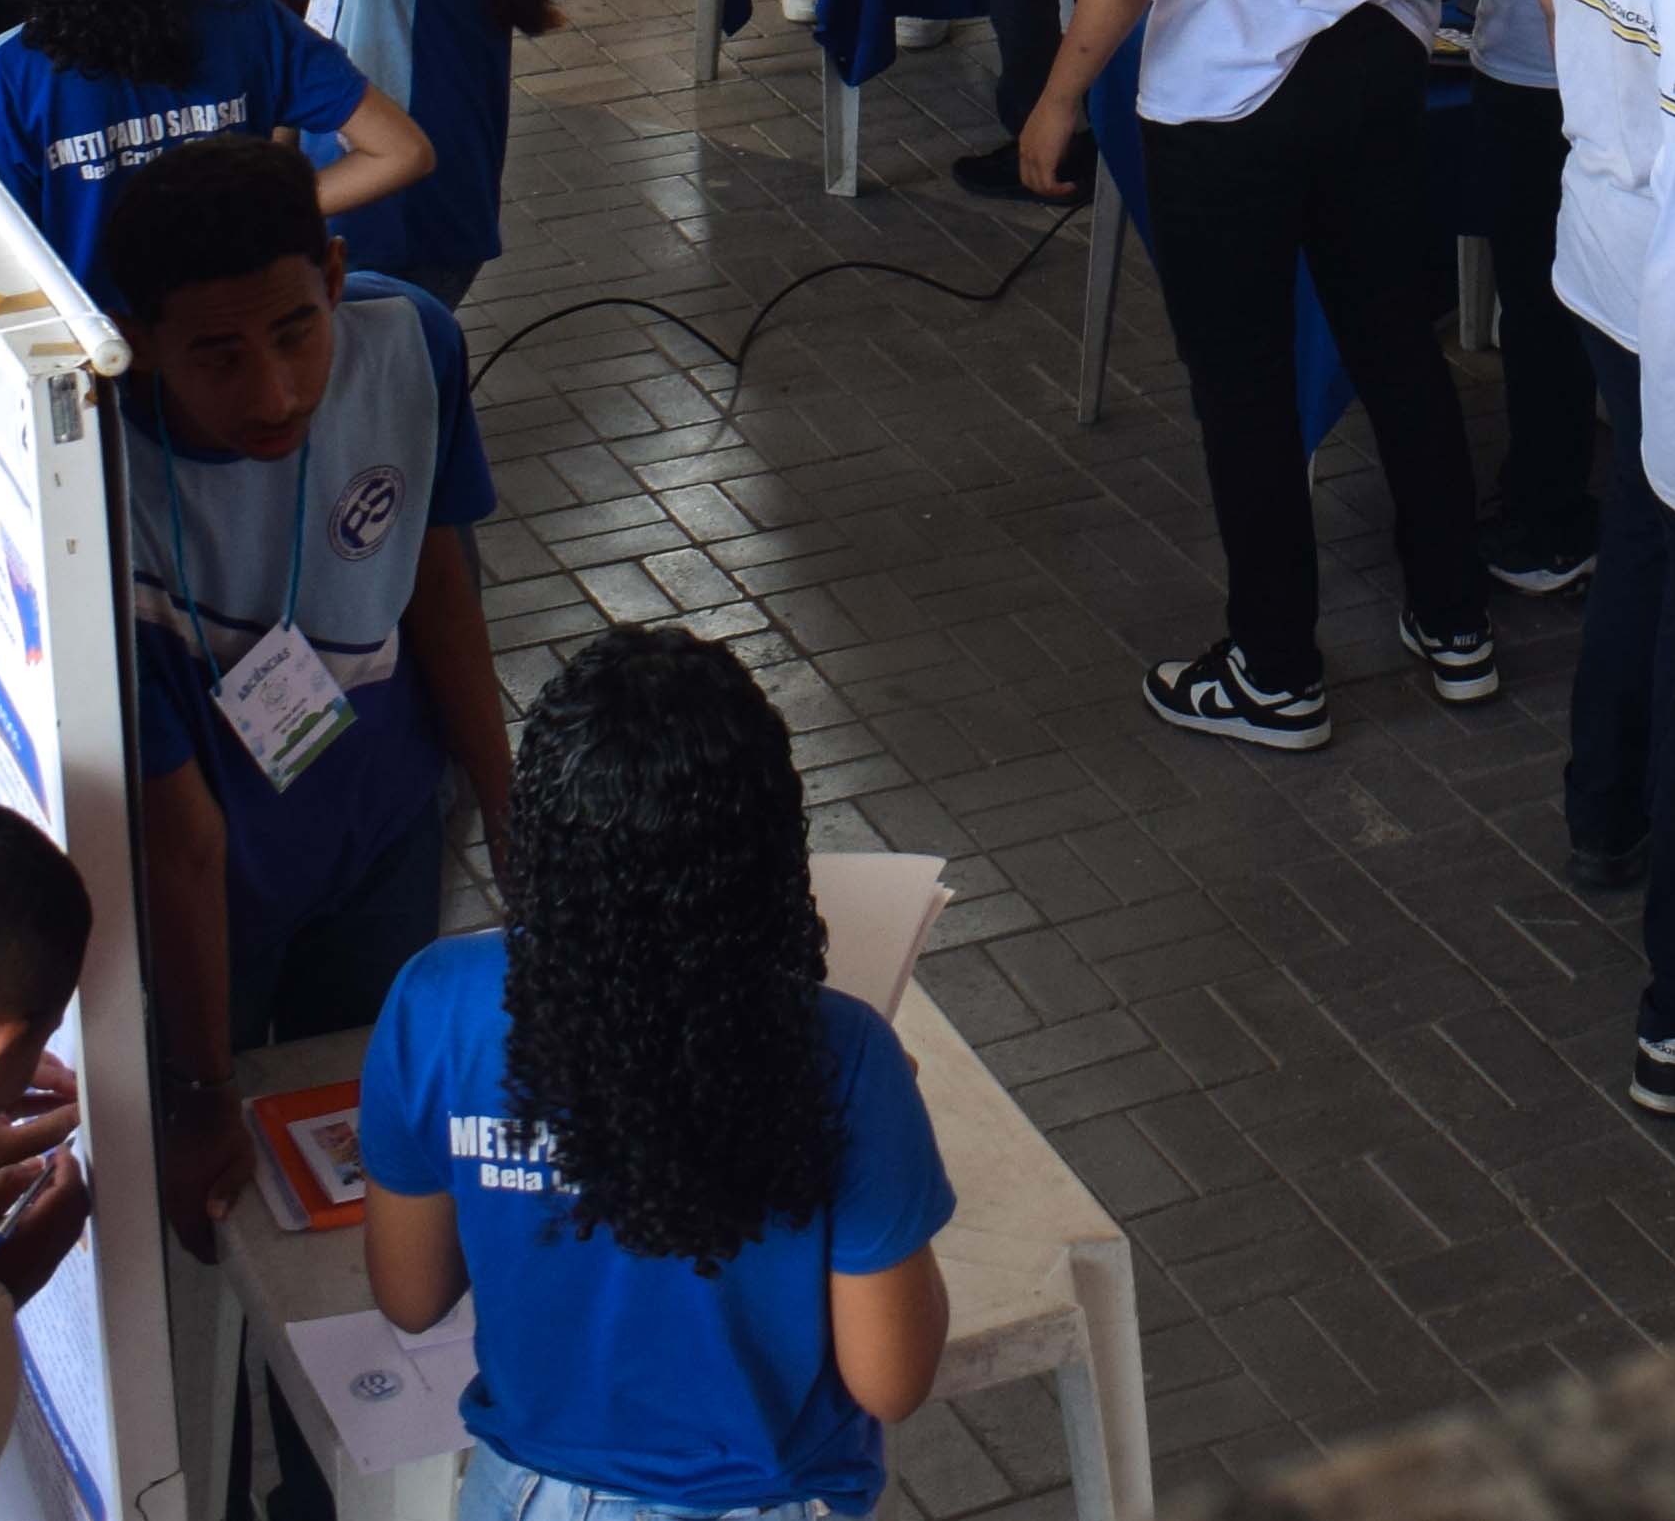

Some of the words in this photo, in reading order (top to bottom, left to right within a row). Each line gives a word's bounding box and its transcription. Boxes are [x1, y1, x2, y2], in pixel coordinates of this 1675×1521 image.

[47, 131, 107, 171] EMETI
[106, 113, 165, 152] PAULO
[165, 93, 247, 137] SARASAT
[480, 1163, 543, 1191] Bela
